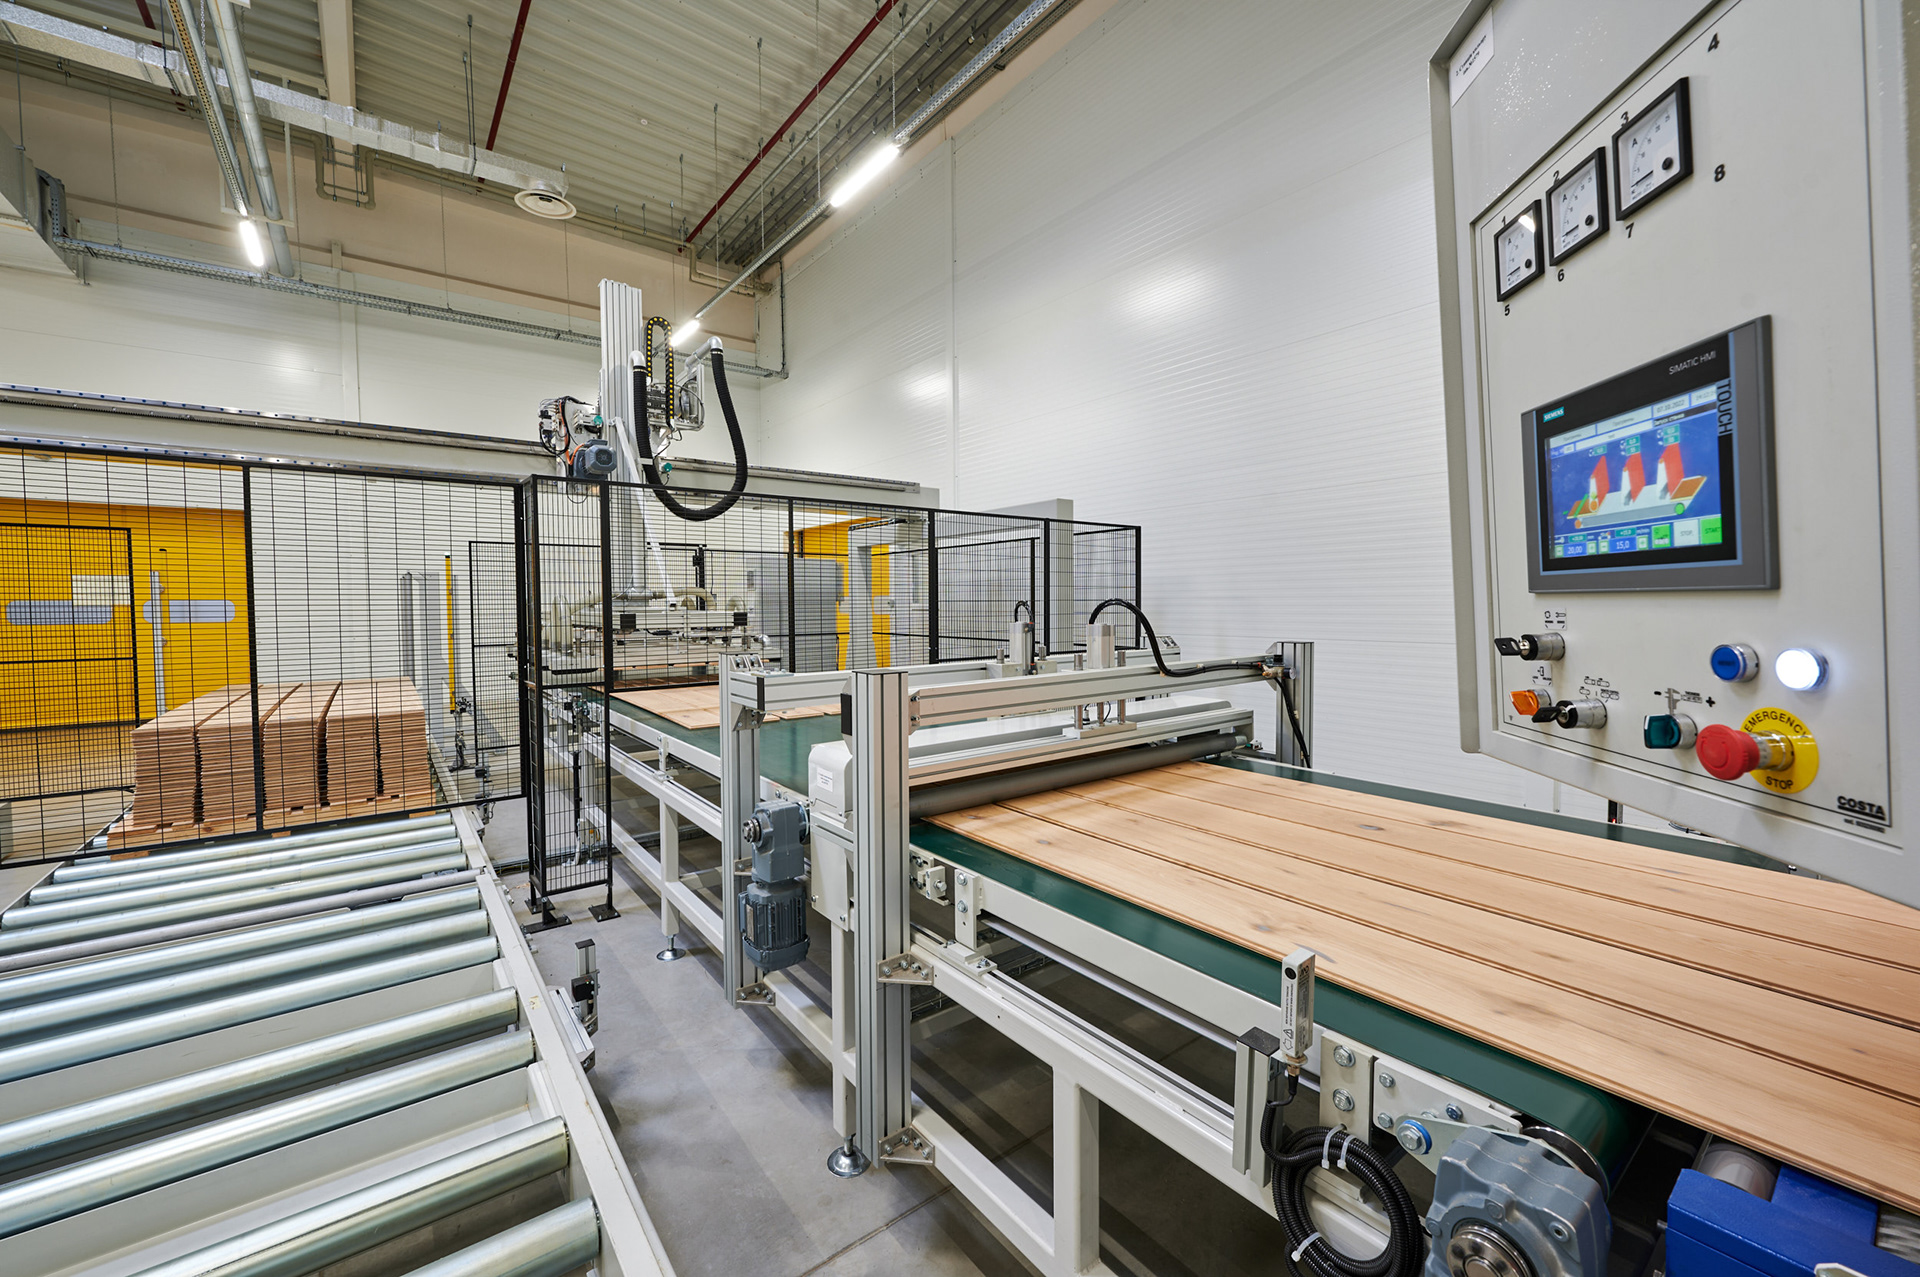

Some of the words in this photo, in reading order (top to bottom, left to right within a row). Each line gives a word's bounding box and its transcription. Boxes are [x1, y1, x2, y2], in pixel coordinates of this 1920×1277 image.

[1707, 32, 1720, 52] 4
[1620, 111, 1629, 127] 3
[1631, 138, 1638, 148] A
[1553, 170, 1560, 182] 2
[1714, 164, 1726, 182] 8
[1562, 193, 1568, 203] A
[1625, 222, 1634, 238] 7
[1557, 269, 1565, 282] 6
[1504, 304, 1511, 316] 5
[1668, 356, 1699, 375] SIMATIC
[1700, 350, 1717, 363] HMI
[1543, 408, 1564, 421] SIEMENS
[1716, 379, 1734, 435] TOUCH
[1616, 540, 1630, 550] 15,0
[1744, 711, 1809, 739] EMERGENCY
[1765, 776, 1794, 790] STOP
[1837, 795, 1886, 816] COSTA
